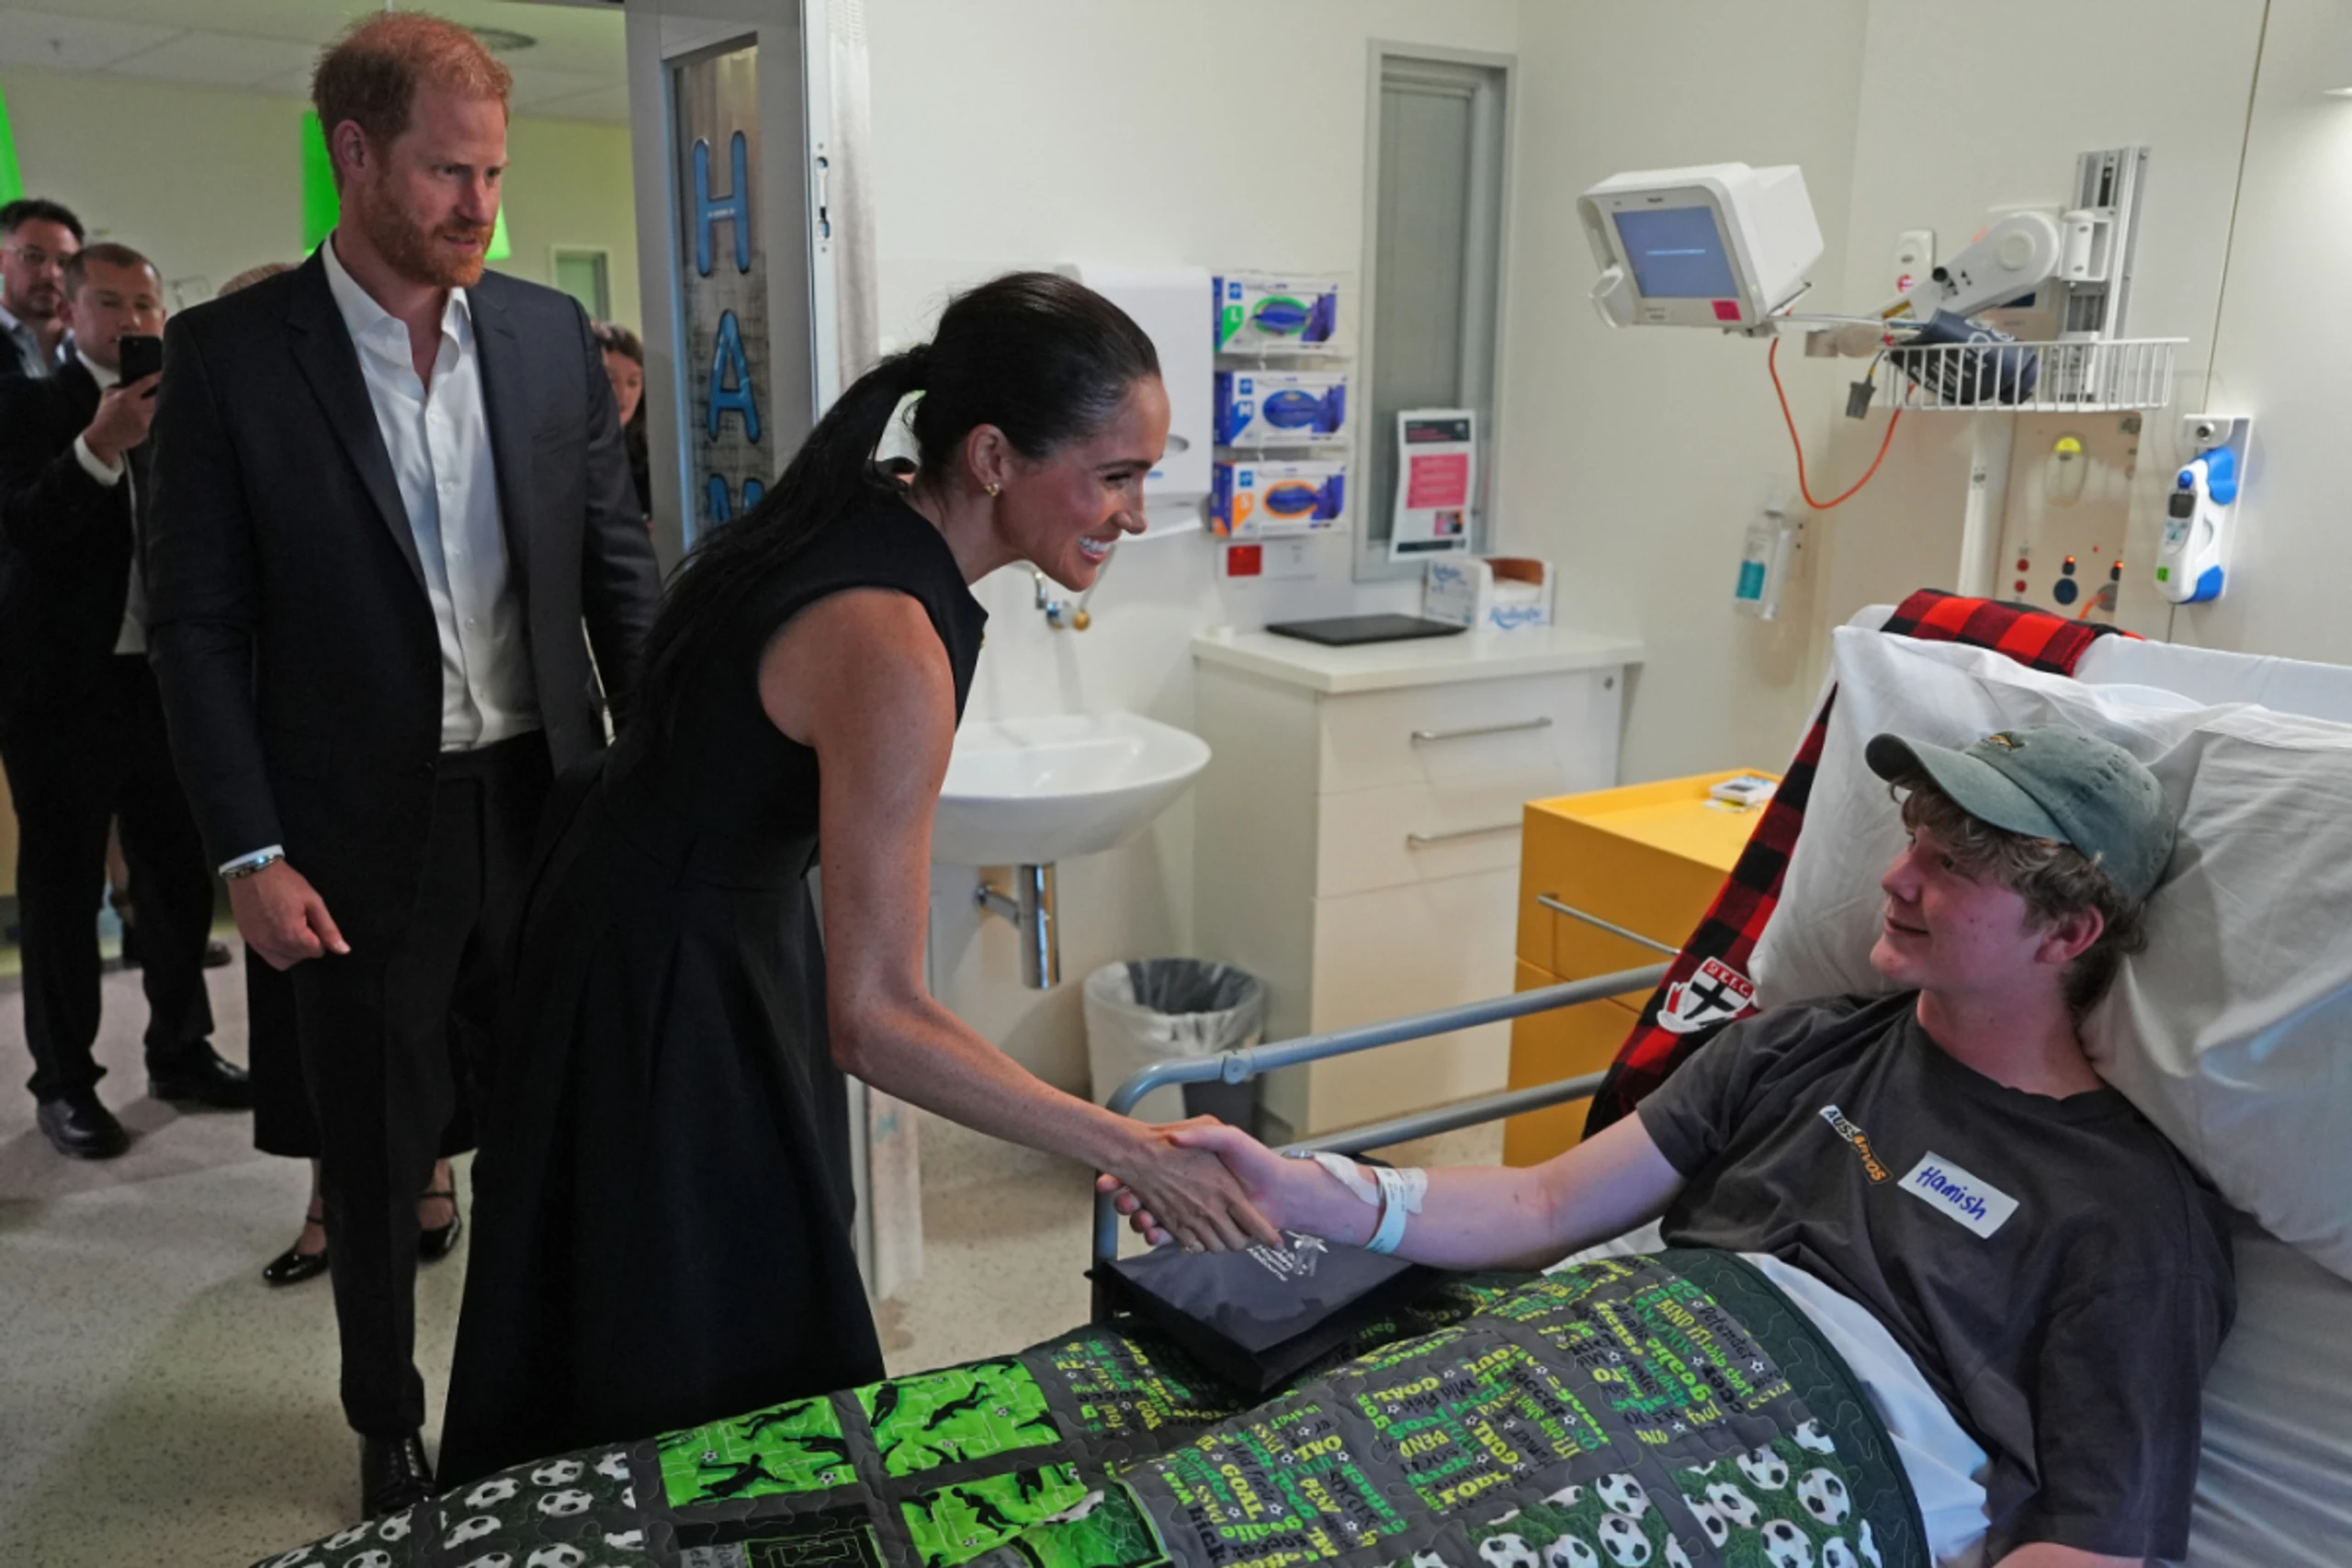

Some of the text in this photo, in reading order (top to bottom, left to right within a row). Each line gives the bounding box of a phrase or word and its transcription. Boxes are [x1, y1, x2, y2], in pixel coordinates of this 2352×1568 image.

[1915, 1165, 1987, 1222] Hamish
[1645, 1337, 1713, 1403] goalie
[1220, 1463, 1265, 1521] GOAL
[1219, 1515, 1304, 1542] goalie
